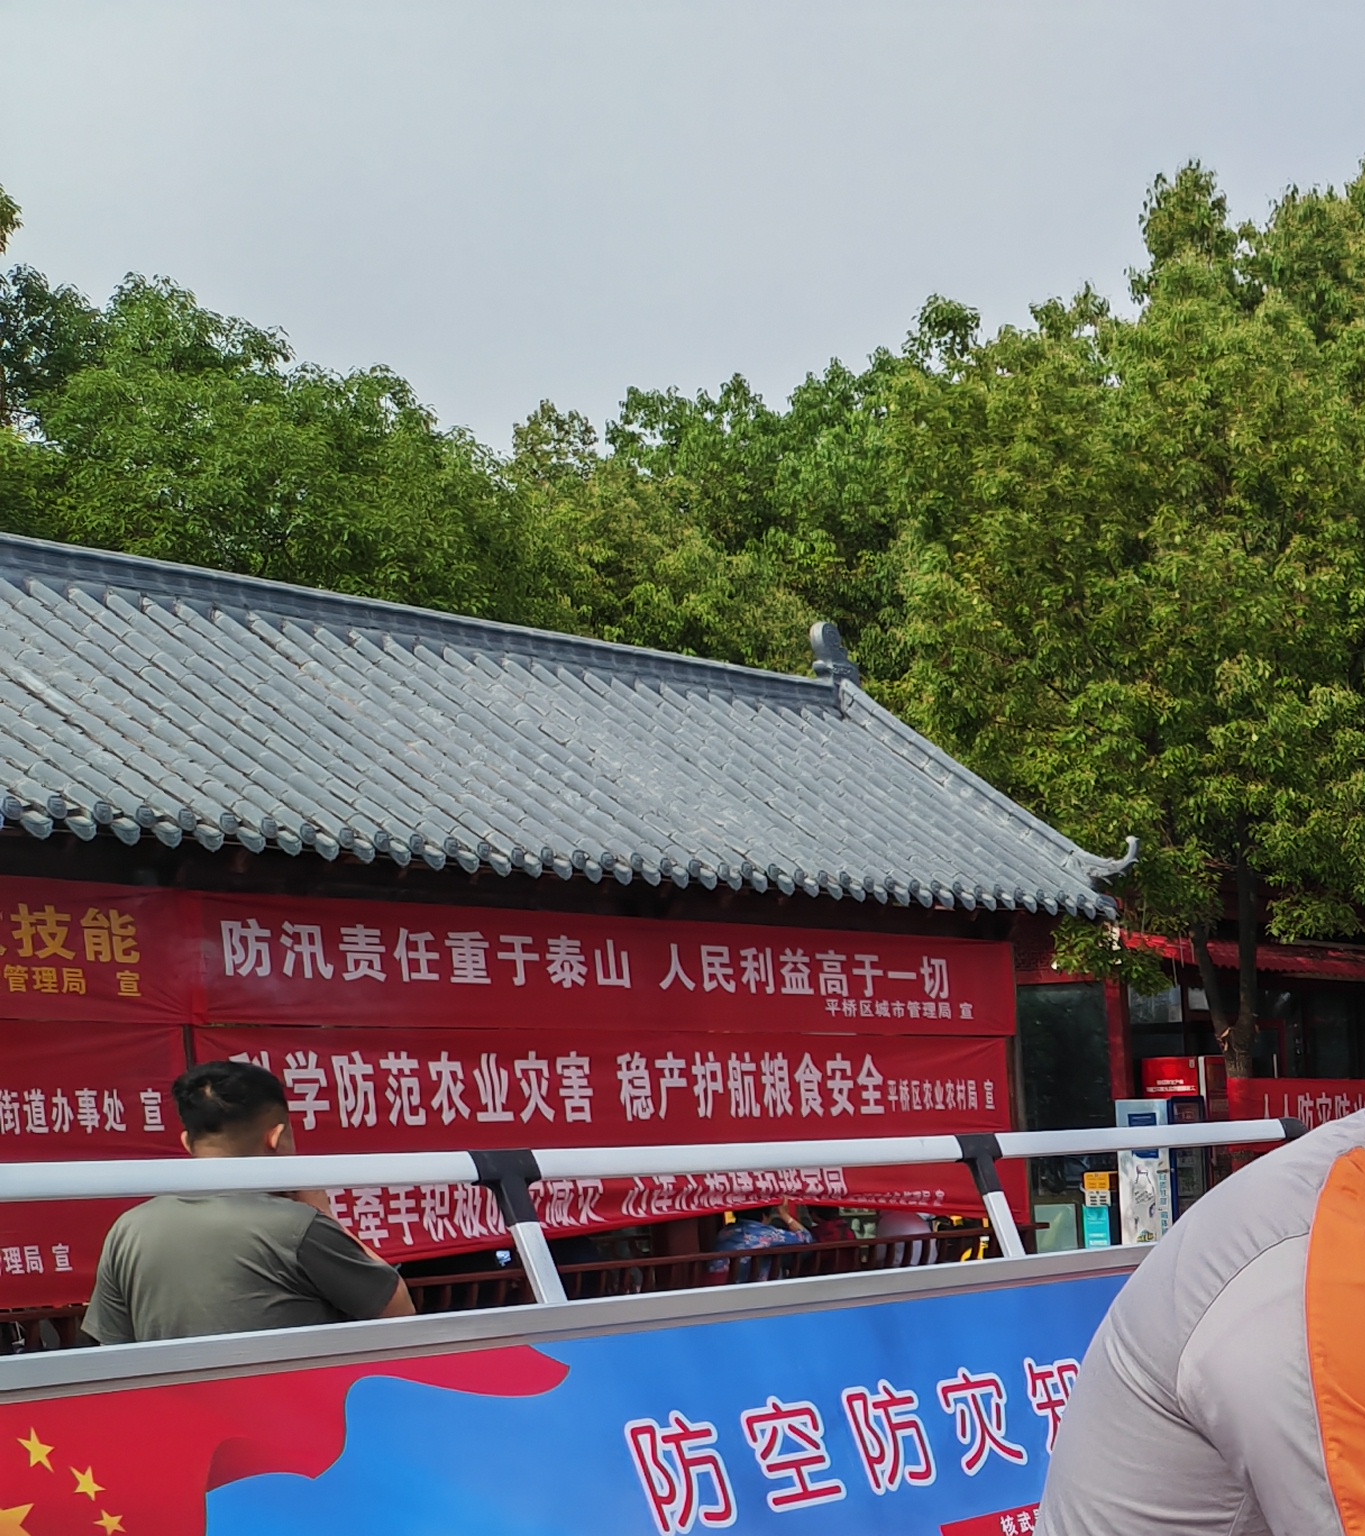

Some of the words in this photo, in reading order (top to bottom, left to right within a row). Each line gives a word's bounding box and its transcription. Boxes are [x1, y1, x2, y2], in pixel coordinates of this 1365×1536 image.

[0, 903, 141, 965] 技能
[220, 918, 632, 990] 防汛责任重于泰山
[659, 943, 950, 999] 人民利益高于一切
[116, 969, 142, 998] 宣
[825, 998, 952, 1020] 平桥区城市管理局
[959, 1001, 974, 1021] 宣
[0, 1087, 127, 1136] 街道办事处
[139, 1086, 166, 1133] 宣
[616, 1051, 885, 1124] 稳产护航粮食安全
[887, 1079, 978, 1114] 平桥区农业农村局
[983, 1079, 996, 1112] 宣
[0, 1243, 44, 1276] 理局
[52, 1242, 74, 1274] 宣
